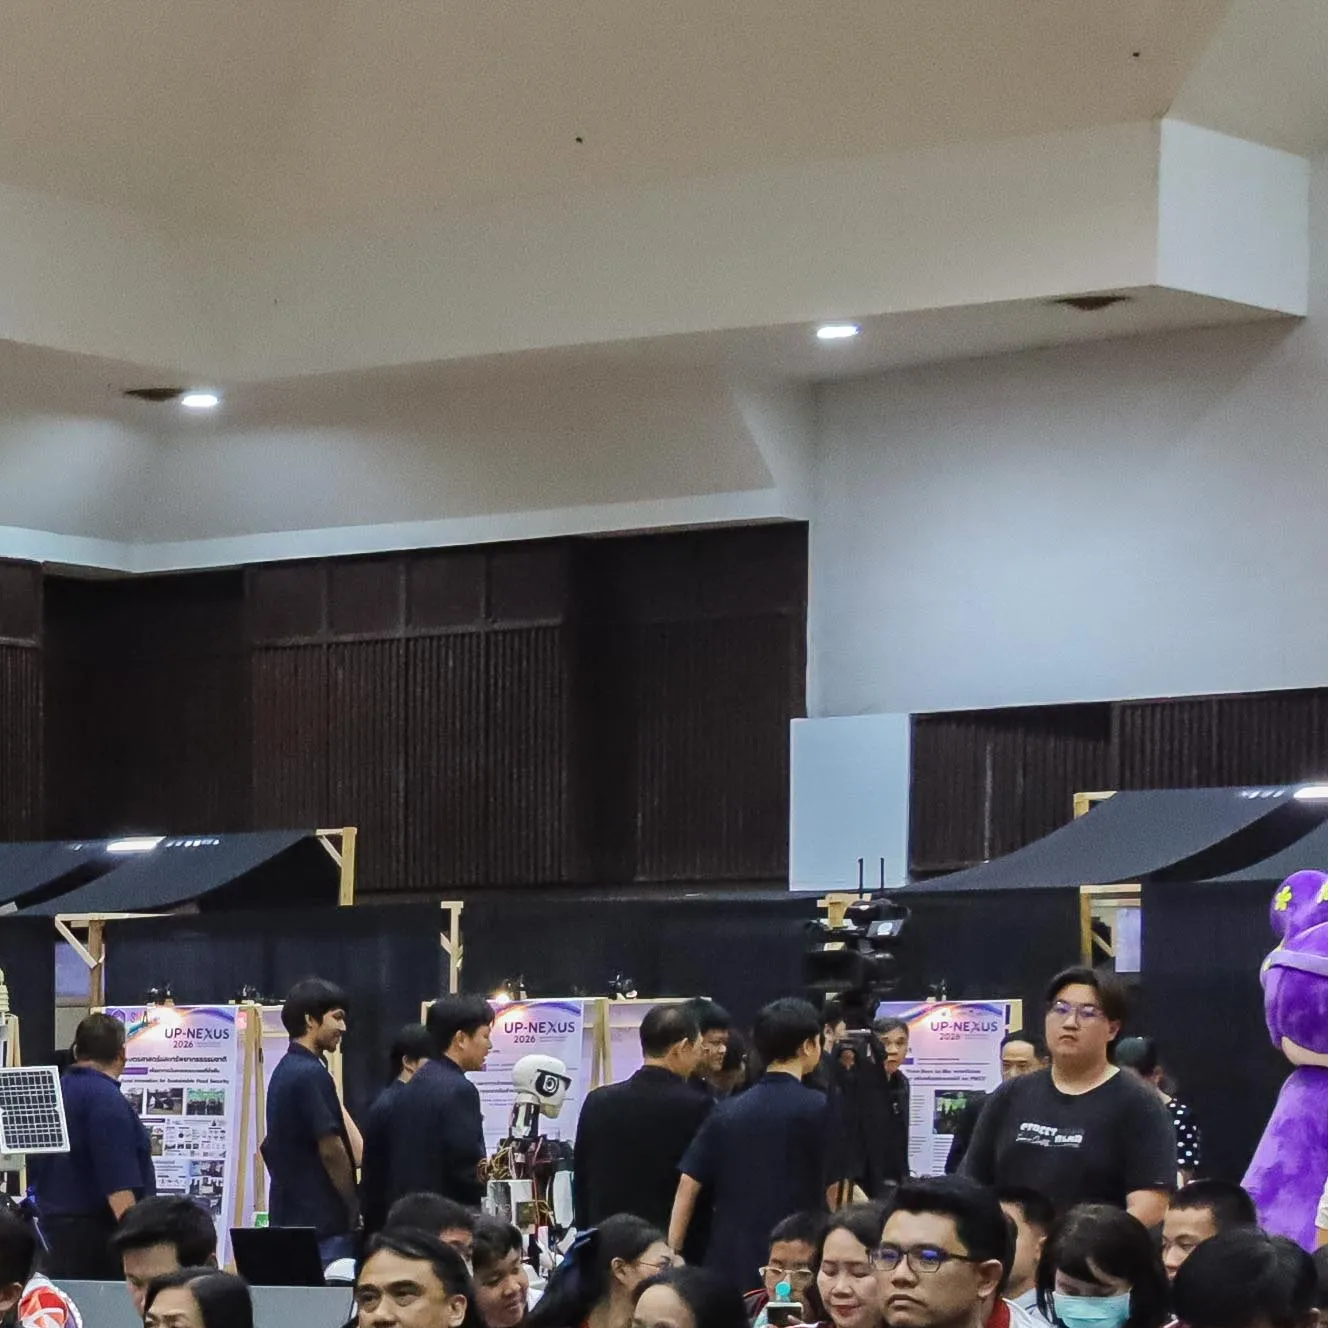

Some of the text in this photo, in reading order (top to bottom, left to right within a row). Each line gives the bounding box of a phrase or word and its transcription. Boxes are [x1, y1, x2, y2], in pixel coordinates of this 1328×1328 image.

[504, 1021, 576, 1035] UP-NEXUS
[931, 1021, 998, 1033] UP-NEXUS
[164, 1027, 230, 1040] UP-NEXUS
[513, 1035, 536, 1043] 2026
[173, 1040, 194, 1049] 2026
